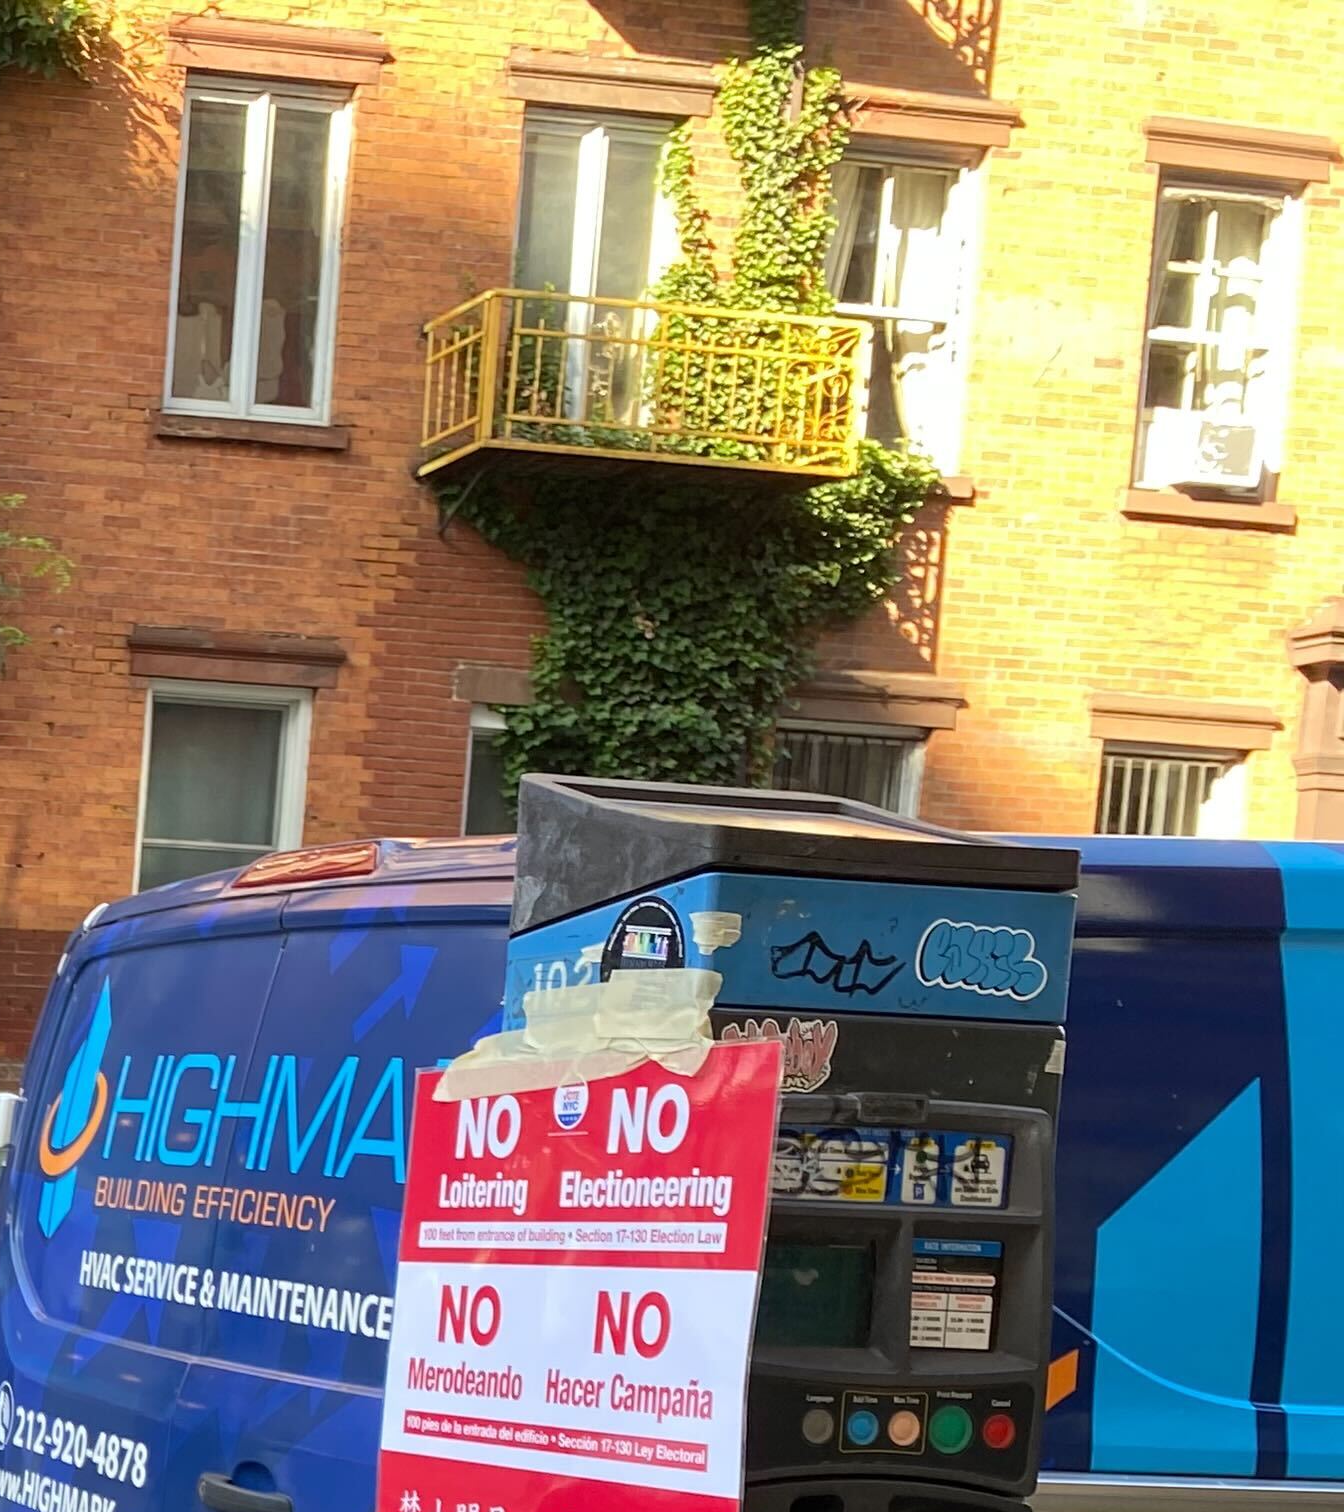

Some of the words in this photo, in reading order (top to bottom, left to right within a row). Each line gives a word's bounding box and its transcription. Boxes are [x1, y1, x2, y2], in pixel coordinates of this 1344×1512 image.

[101, 1054, 407, 1184] HIGHMA
[454, 1095, 521, 1160] NO
[607, 1084, 690, 1155] NO
[563, 1102, 578, 1111] NYC
[94, 1176, 185, 1216] BUILDING
[192, 1186, 336, 1234] EFFICIENCY
[439, 1173, 528, 1216] Loitering
[559, 1168, 732, 1217] Electioneering
[424, 1229, 437, 1240] 100
[439, 1229, 455, 1241] feet
[457, 1230, 475, 1241] from
[477, 1230, 515, 1242] entrance
[517, 1229, 527, 1242] of
[528, 1229, 565, 1245] building
[575, 1230, 612, 1243] Section
[616, 1230, 647, 1244] 17-130
[650, 1230, 696, 1244] Election
[698, 1232, 721, 1244] Law
[79, 1251, 124, 1293] HVAC
[125, 1257, 199, 1307] SERVICE
[199, 1270, 215, 1307] &
[218, 1270, 393, 1340] MAINTENANCE
[438, 1285, 502, 1347] NO
[593, 1291, 671, 1358] NO
[408, 1357, 522, 1401] Merodeando
[546, 1368, 604, 1408] Hacer
[610, 1379, 712, 1424] Campaña
[13, 1406, 148, 1488] 212-920-4878
[407, 1415, 421, 1430] 100
[421, 1418, 439, 1433] pies
[441, 1421, 453, 1433] de
[454, 1421, 462, 1435] la
[463, 1423, 497, 1439] entrada
[499, 1426, 513, 1440] del
[515, 1428, 548, 1445] edificio
[558, 1432, 598, 1451] Sección
[601, 1439, 632, 1456] 17-130
[635, 1442, 653, 1463] Ley
[656, 1445, 705, 1465] Electoral
